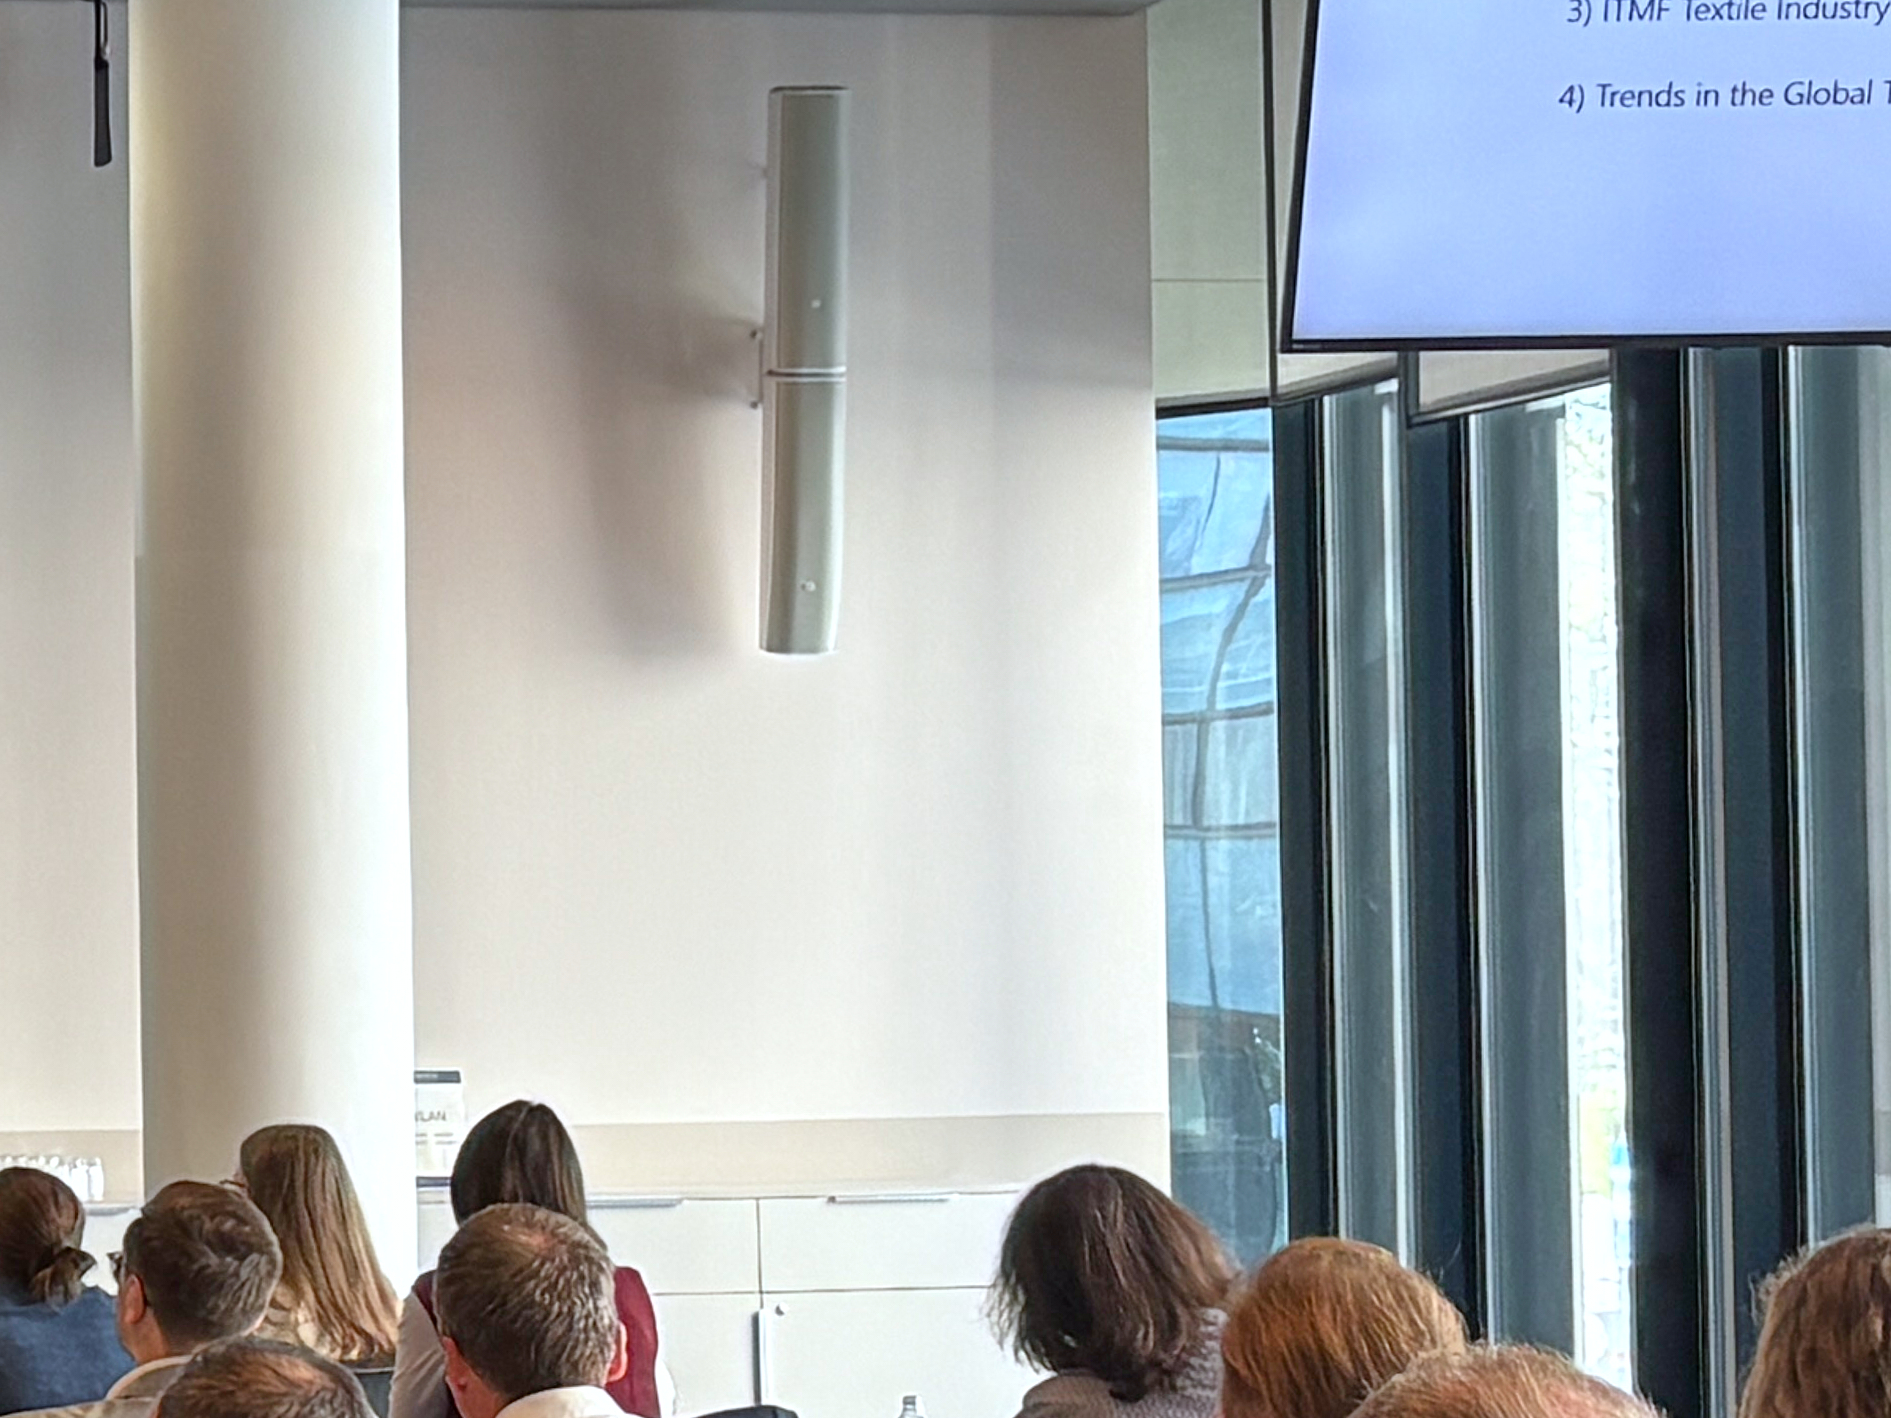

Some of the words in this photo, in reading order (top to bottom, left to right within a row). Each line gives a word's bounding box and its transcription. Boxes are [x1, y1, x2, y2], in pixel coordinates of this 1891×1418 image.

[1558, 84, 1585, 114] 4)
[1596, 80, 1686, 108] Trends
[1695, 82, 1720, 107] in
[1730, 80, 1775, 107] the
[1783, 78, 1873, 106] Global
[415, 1110, 447, 1122] LAN
